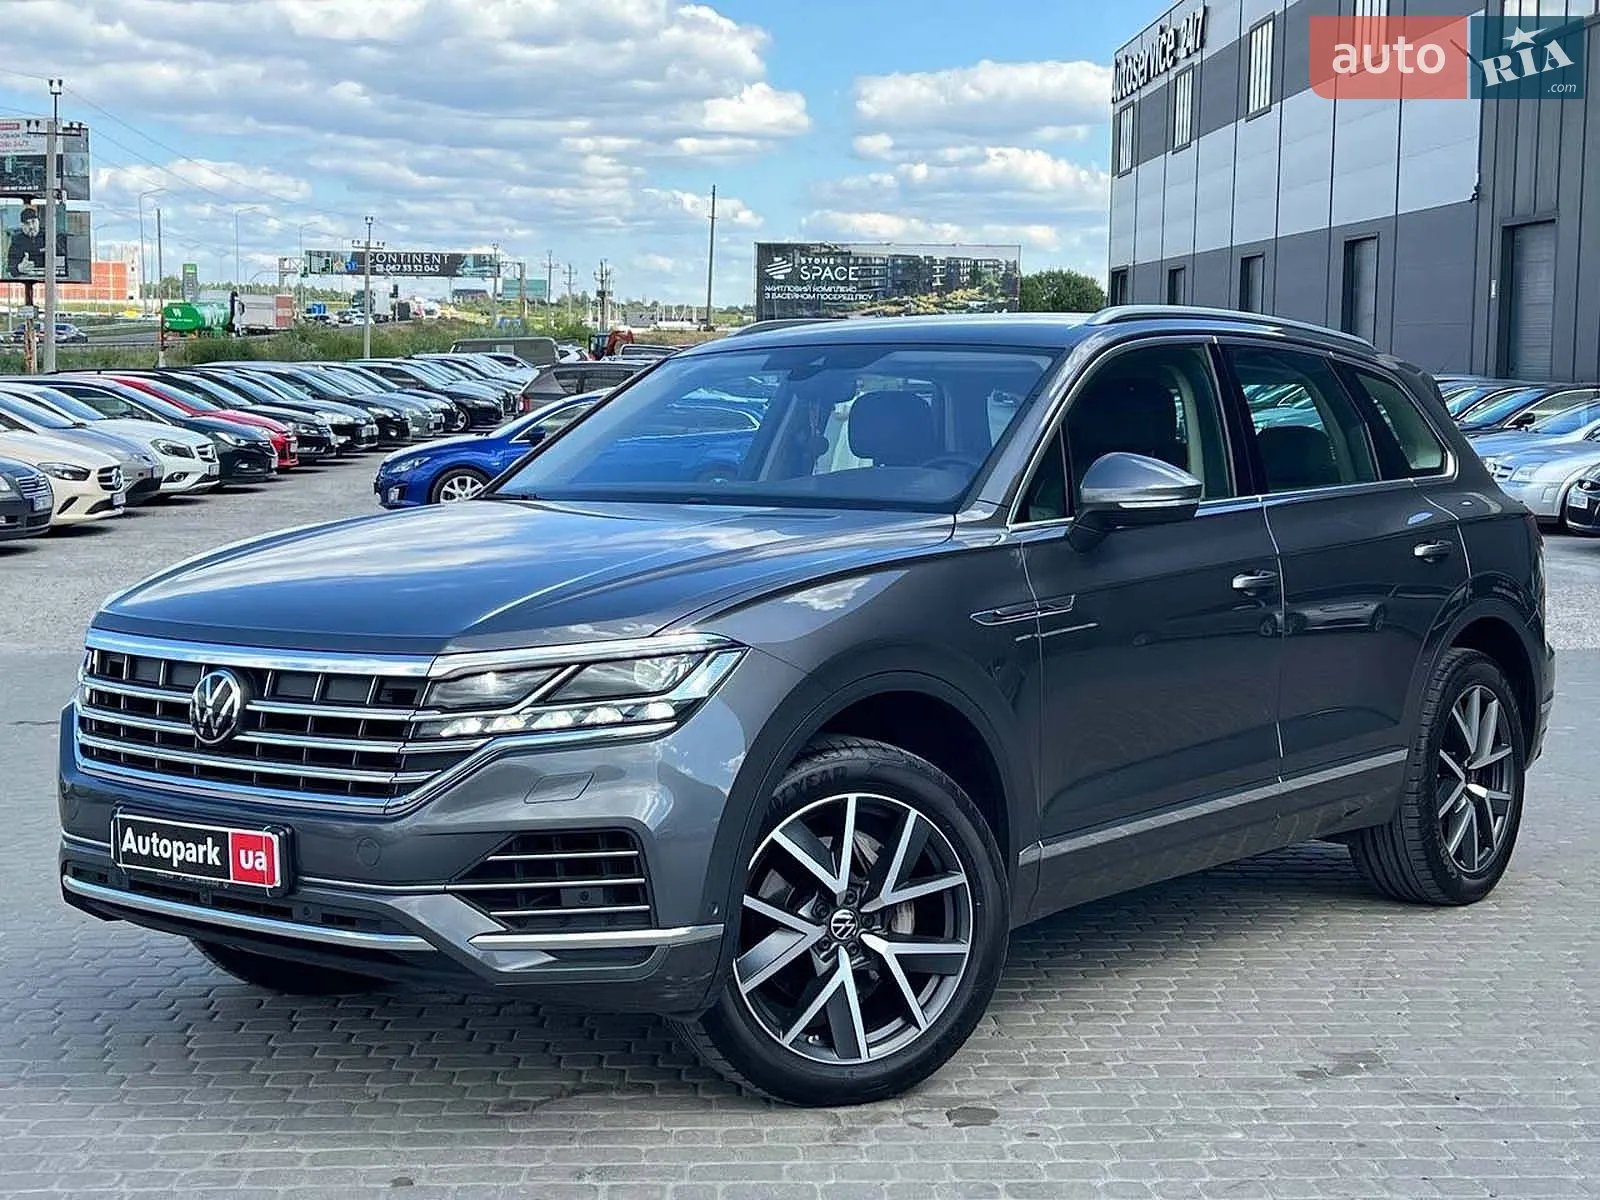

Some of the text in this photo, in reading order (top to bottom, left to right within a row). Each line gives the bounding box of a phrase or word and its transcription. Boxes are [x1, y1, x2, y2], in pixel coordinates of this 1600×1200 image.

[369, 253, 450, 264] CONTINENT
[800, 266, 859, 281] SPACE
[121, 827, 268, 872] Autopark ua
